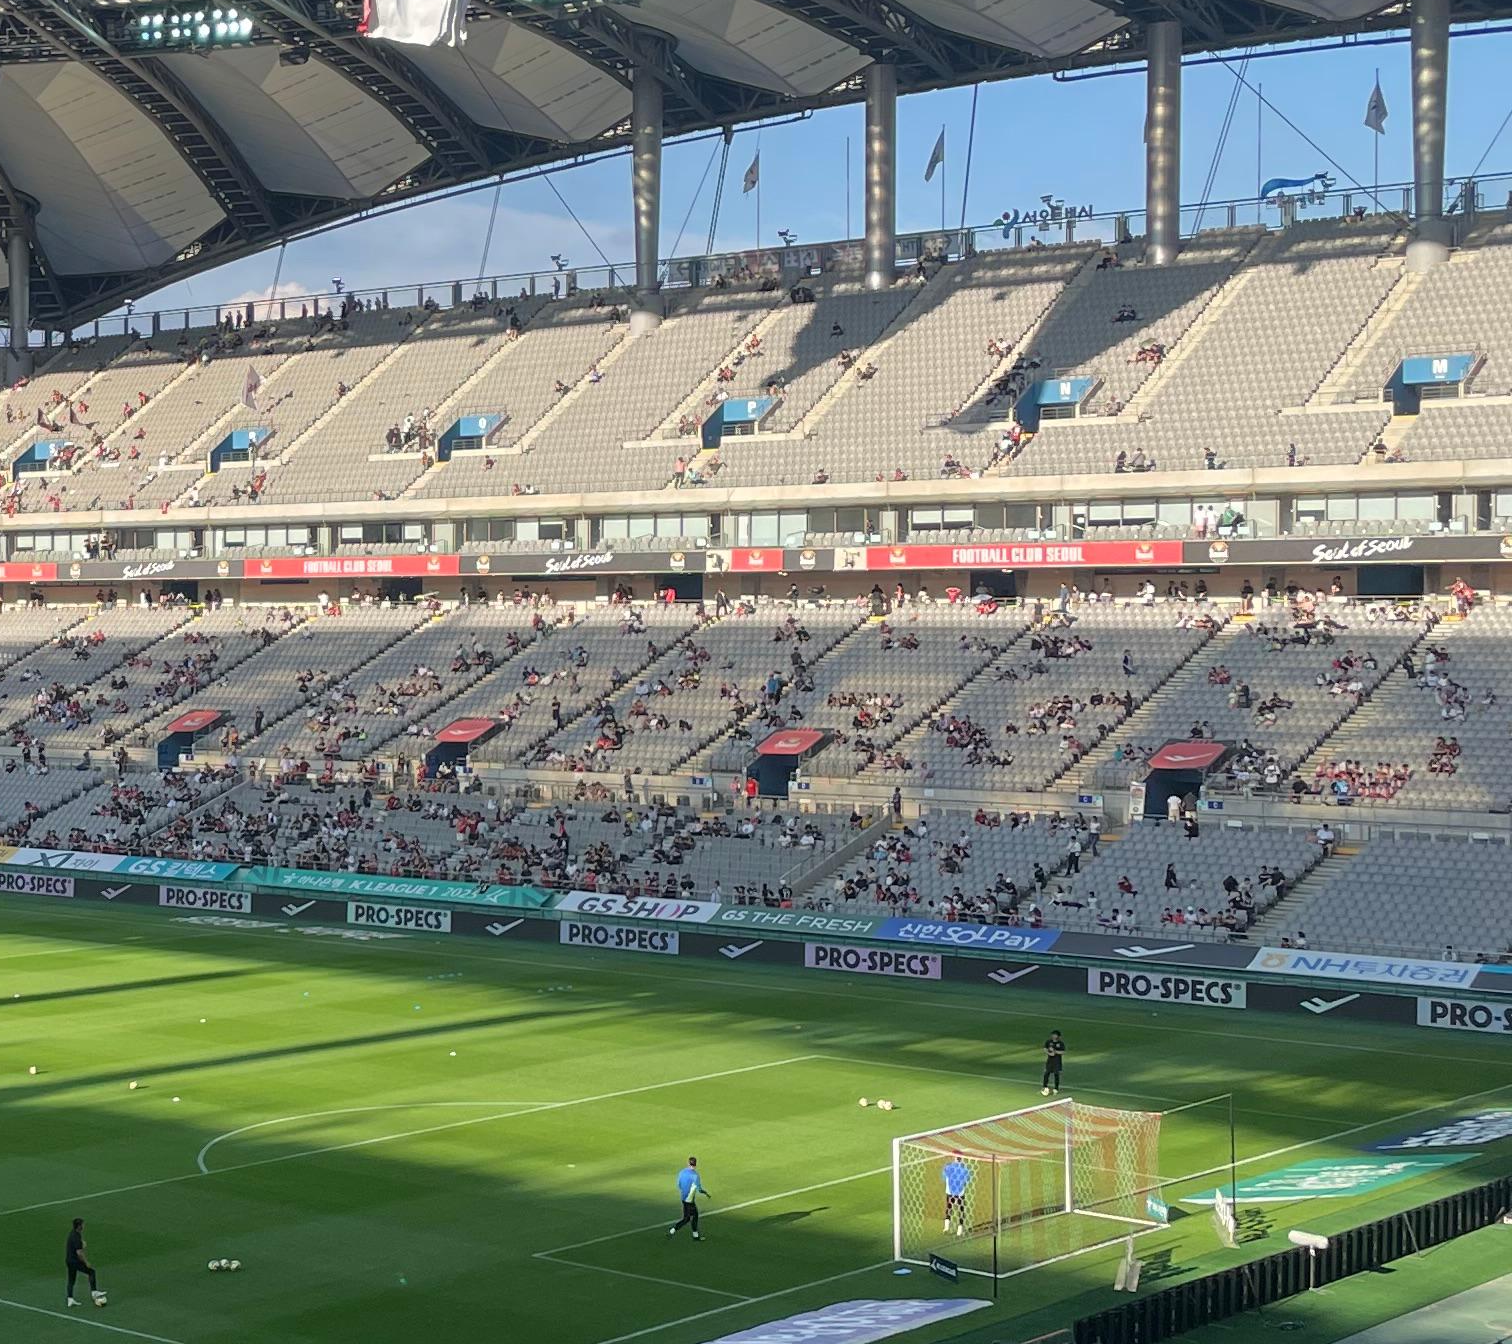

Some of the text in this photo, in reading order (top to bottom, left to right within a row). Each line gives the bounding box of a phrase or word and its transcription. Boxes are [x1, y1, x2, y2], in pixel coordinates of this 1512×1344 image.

[1432, 359, 1448, 373] M
[1060, 382, 1071, 395] N
[747, 401, 757, 414] P
[952, 546, 1085, 564] FOOTBALL CLUB SEOUL
[303, 559, 393, 574] FOOTBALL CLUB SEOUL
[349, 880, 363, 889] K
[365, 881, 430, 897] LEAGUE
[431, 887, 438, 897] 1
[578, 896, 700, 919] GS SHOP
[722, 909, 873, 933] GS THE FRESH
[898, 923, 940, 940] 신한
[987, 930, 1041, 951] Pay
[1291, 955, 1471, 984] NH투자증권
